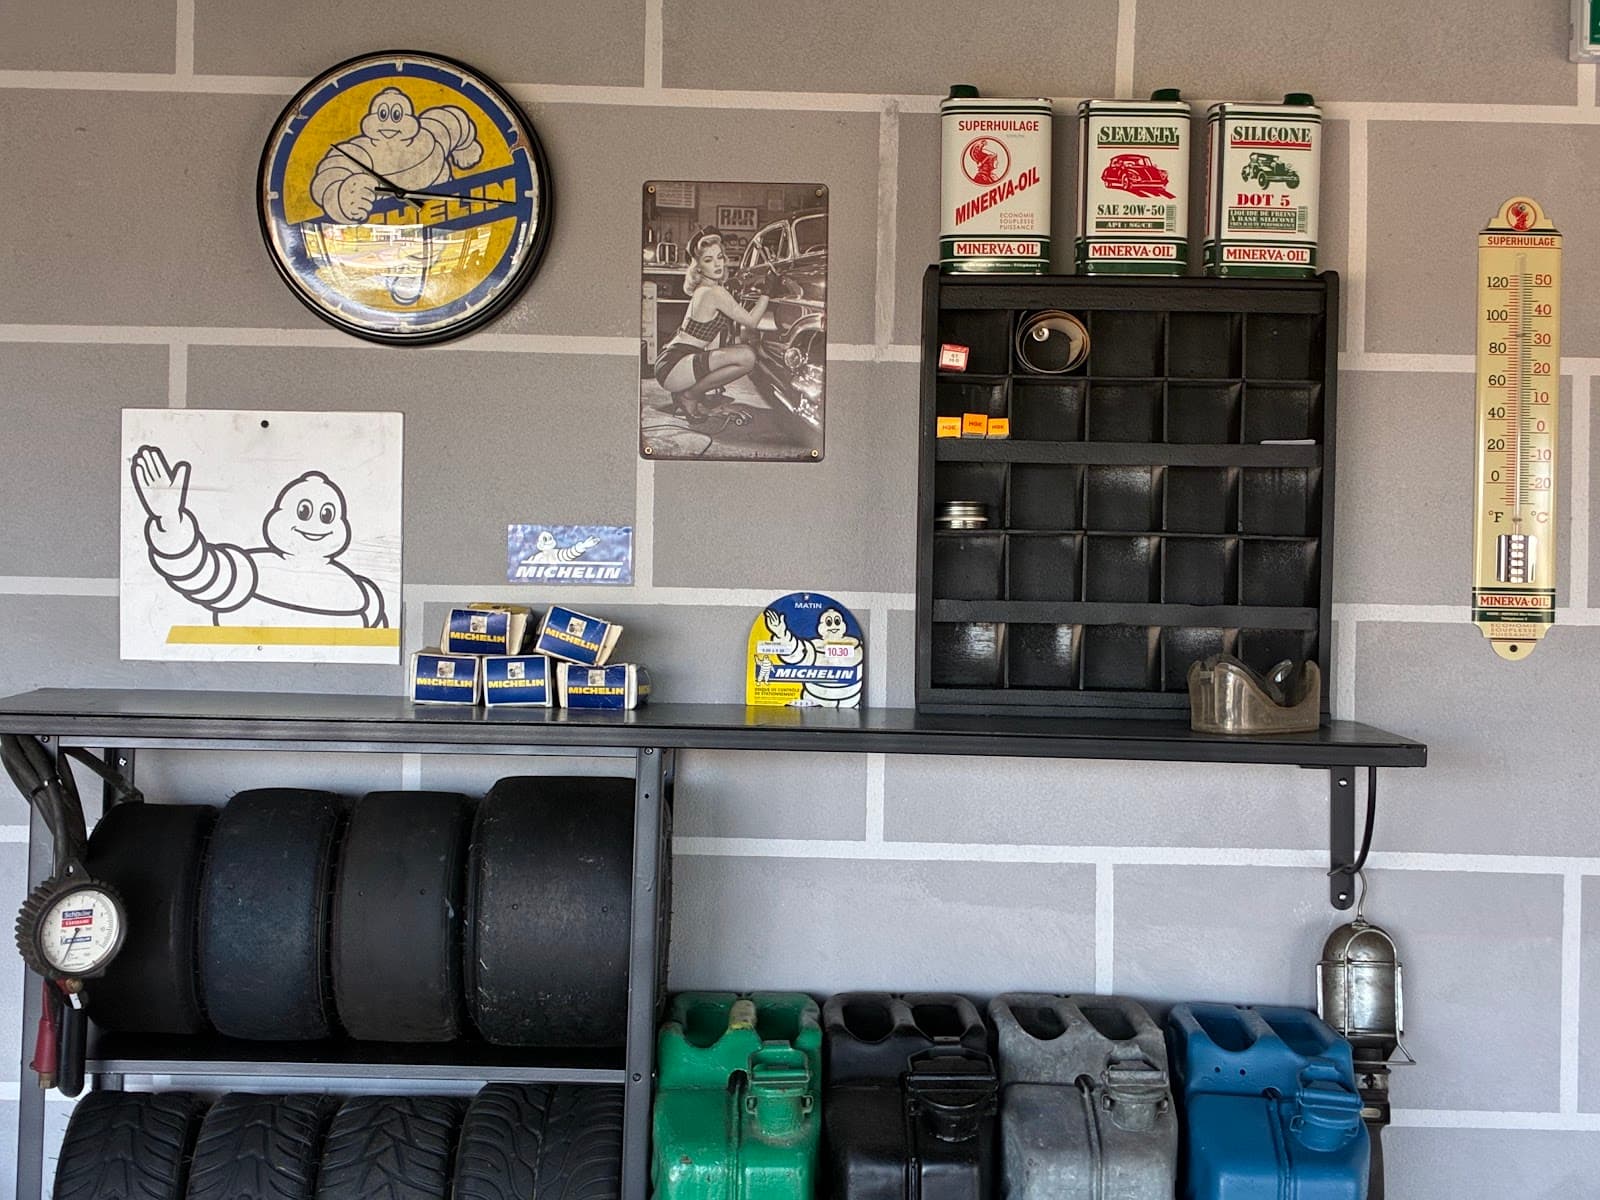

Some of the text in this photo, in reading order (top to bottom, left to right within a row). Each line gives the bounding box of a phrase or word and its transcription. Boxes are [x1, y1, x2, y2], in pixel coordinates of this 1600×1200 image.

[958, 120, 1039, 132] SUPERHUILAGE
[1098, 126, 1179, 143] SEVENTY
[1232, 126, 1312, 143] SILICONE
[1237, 193, 1290, 207] DOT 5
[1097, 204, 1165, 216] SAE 20W-50
[1487, 236, 1556, 246] SUPERHUILAGE
[1487, 276, 1509, 288] 120
[1535, 274, 1552, 286] 50
[1486, 309, 1508, 321] 100
[1534, 304, 1552, 315] 40
[1534, 333, 1551, 345] 30
[1488, 342, 1507, 354] 80
[1533, 362, 1551, 374] 20
[1488, 375, 1506, 386] 60
[1533, 392, 1549, 403] 10
[1487, 407, 1506, 418] 40
[1536, 420, 1545, 431] 0
[1487, 439, 1505, 450] 20
[1530, 449, 1551, 460] -10
[1491, 470, 1500, 482] 0
[1529, 478, 1551, 489] -20
[515, 565, 621, 579] MICHELIN
[450, 631, 506, 643] MICHELIN
[545, 627, 599, 651] MICHELIN
[827, 647, 849, 657] 10.30
[775, 668, 854, 679] MICHELIN
[416, 677, 473, 688] MICHELIN
[488, 678, 545, 689] MICHELIN
[568, 685, 624, 695] MICHELIN
